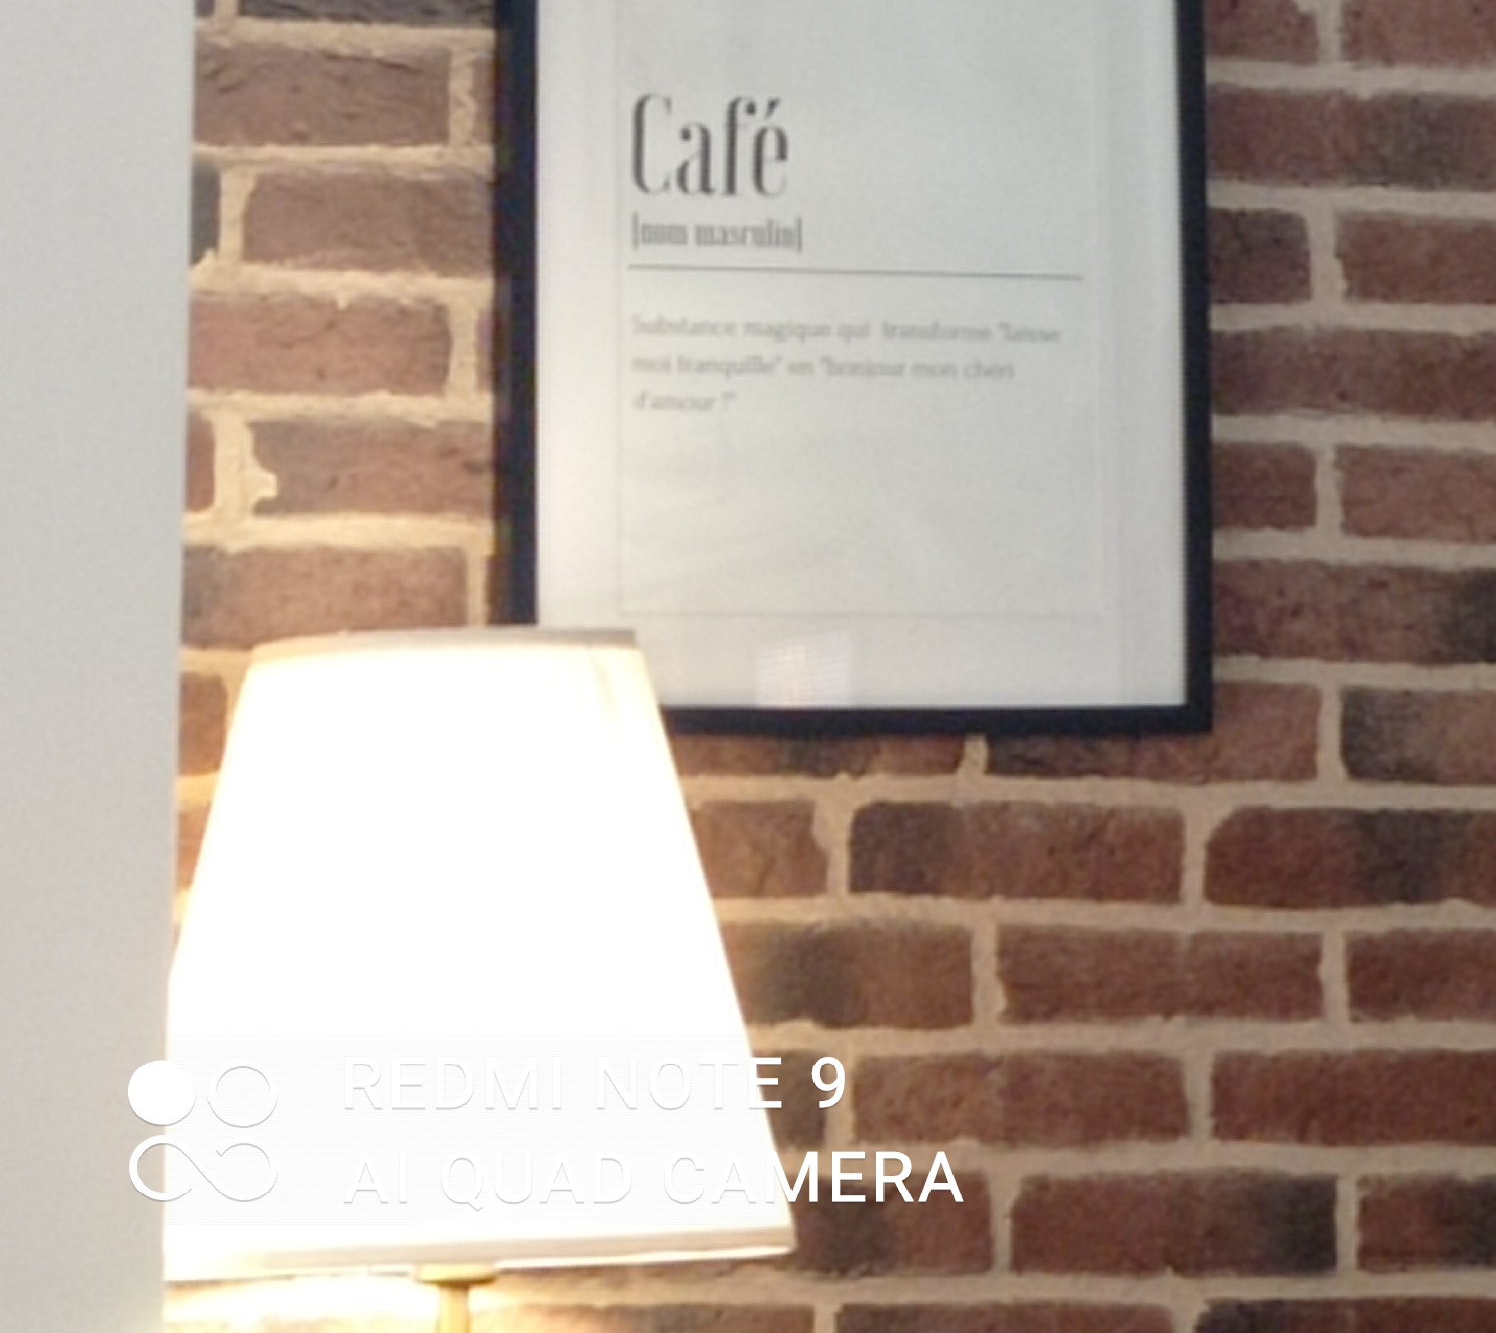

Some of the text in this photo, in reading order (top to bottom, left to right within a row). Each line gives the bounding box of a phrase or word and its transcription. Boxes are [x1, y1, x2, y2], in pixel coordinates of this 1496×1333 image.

[631, 93, 789, 197] Café
[743, 318, 832, 343] magique
[838, 320, 871, 344] qui
[787, 361, 815, 375] en
[911, 362, 958, 377] mon
